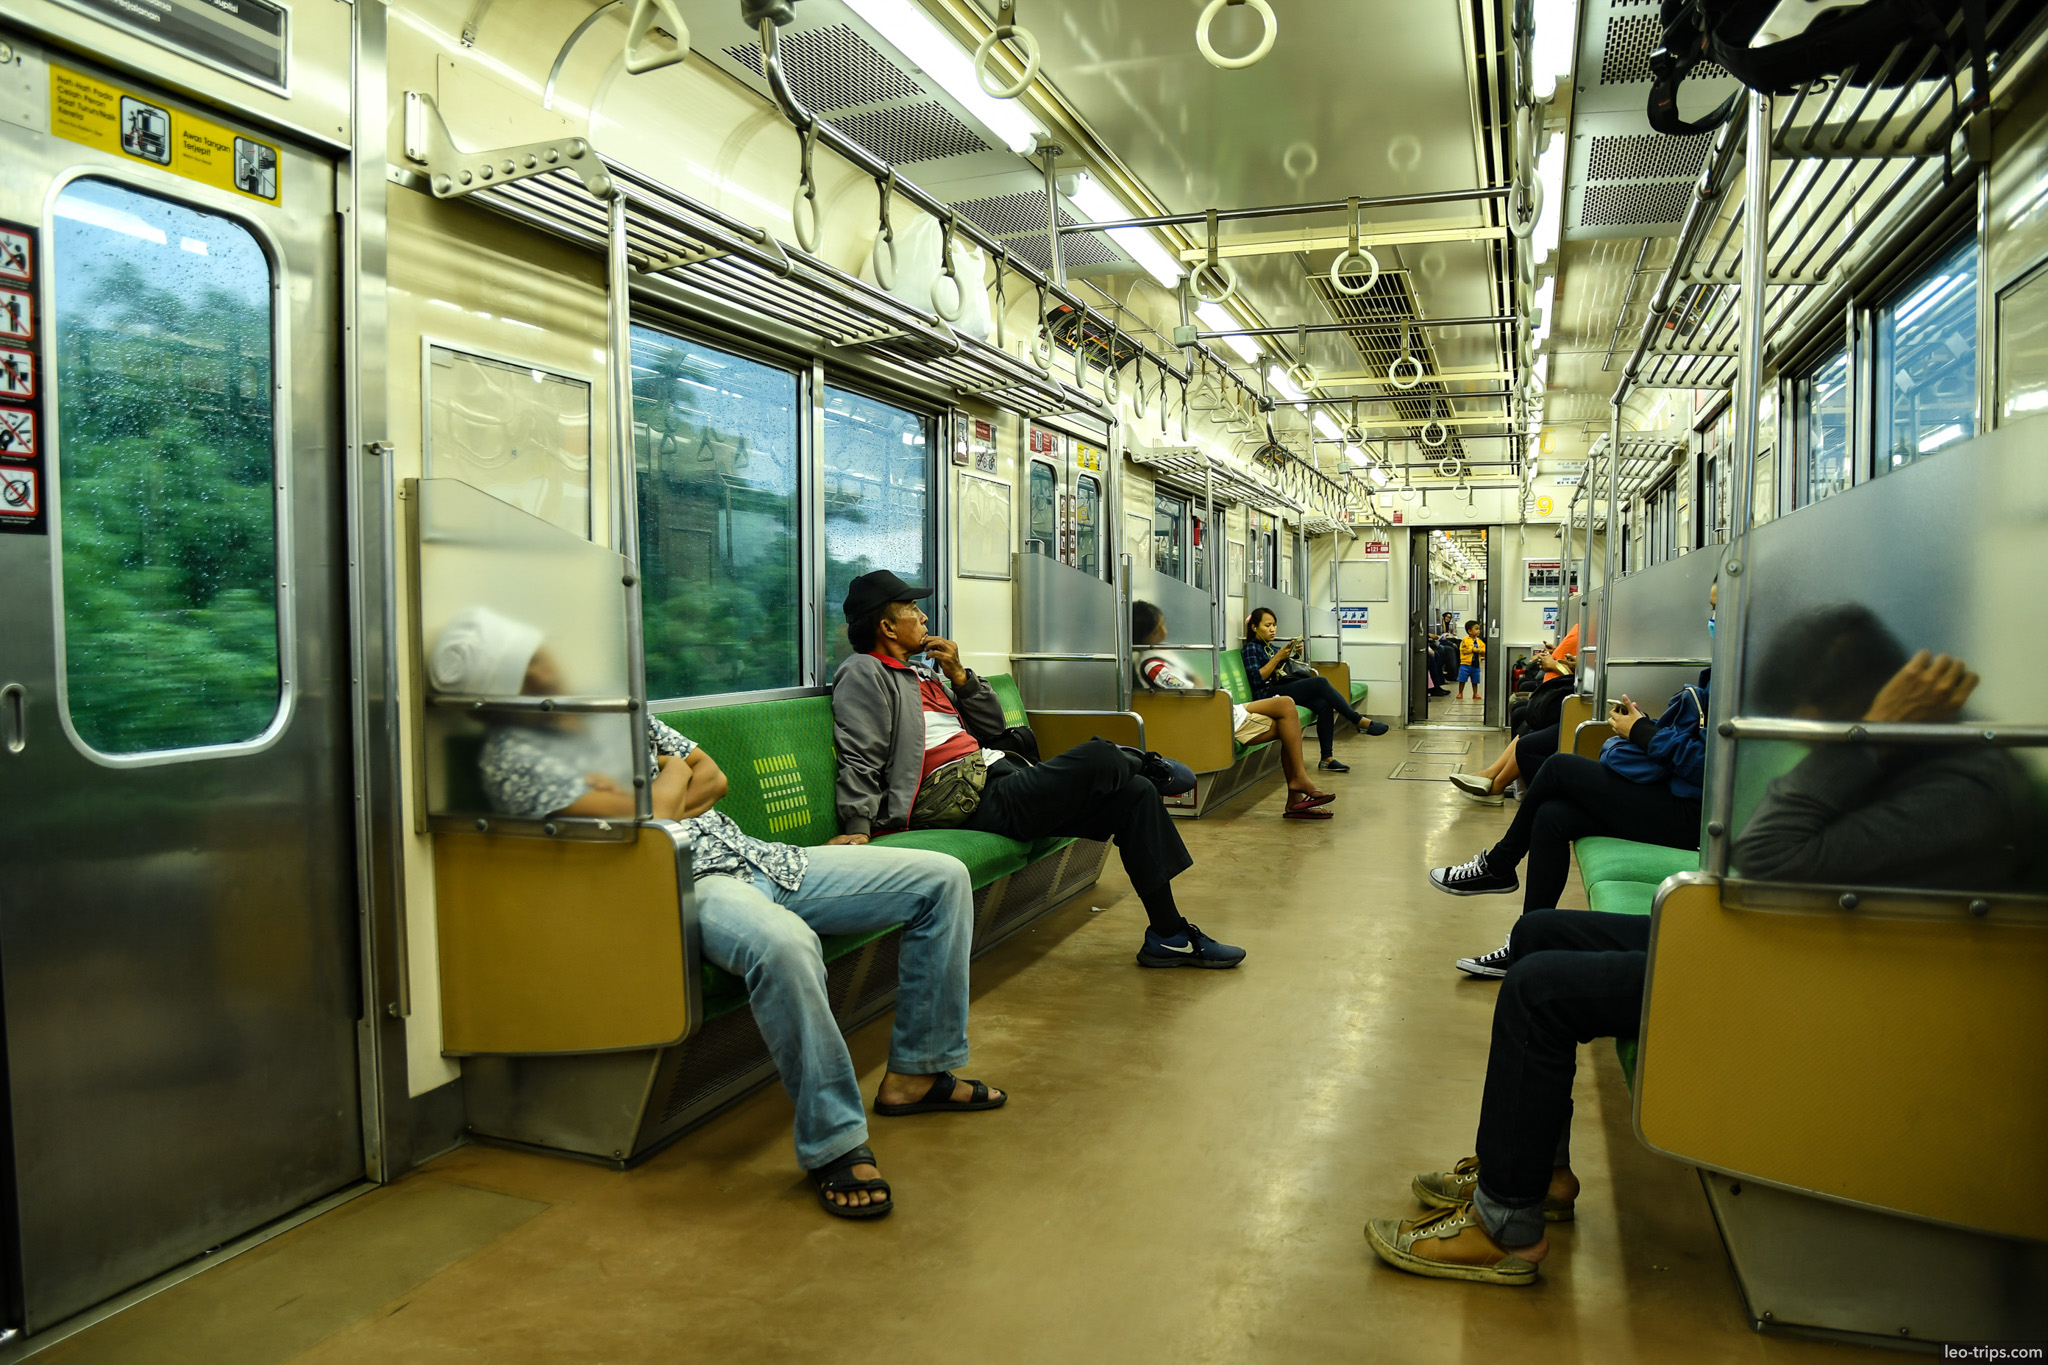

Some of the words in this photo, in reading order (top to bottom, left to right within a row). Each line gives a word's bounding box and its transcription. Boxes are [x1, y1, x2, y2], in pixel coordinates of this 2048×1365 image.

[183, 130, 202, 143] Awas
[204, 136, 231, 152] Tangan
[183, 140, 211, 156] Terjepit
[1537, 496, 1553, 516] 9
